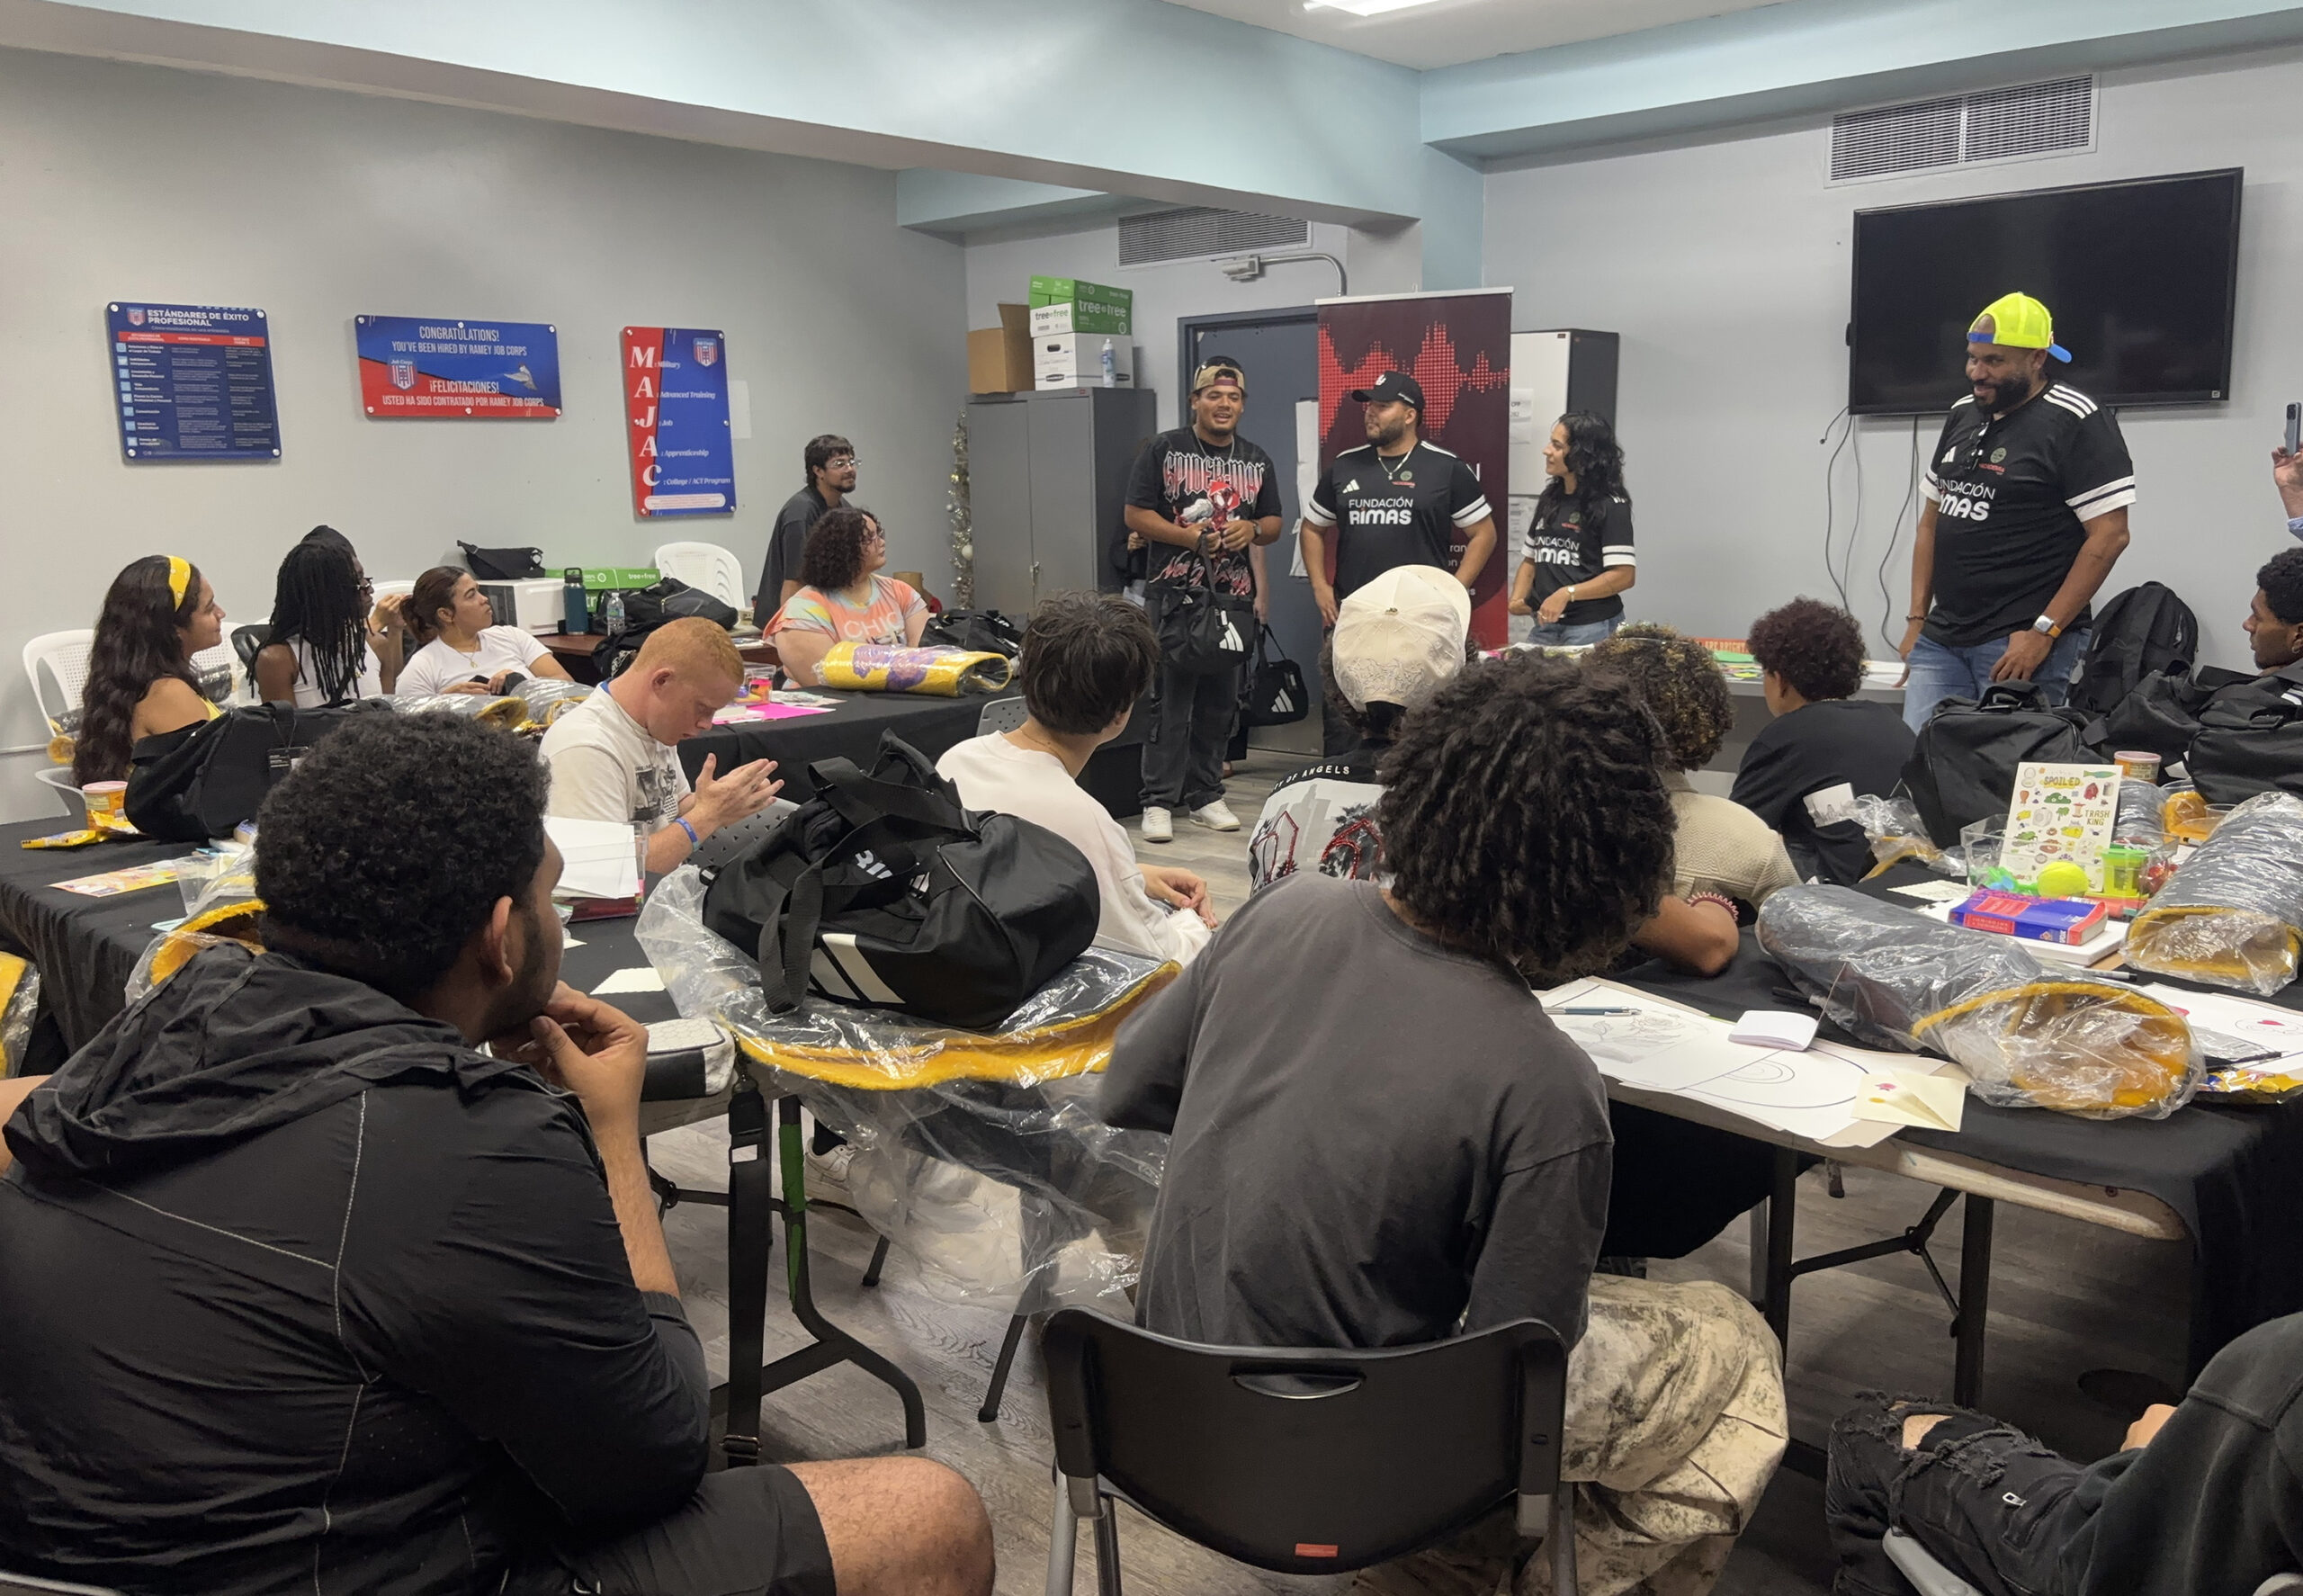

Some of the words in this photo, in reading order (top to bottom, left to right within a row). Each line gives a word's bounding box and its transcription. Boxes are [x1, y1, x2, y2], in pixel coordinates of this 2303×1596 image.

[147, 308, 207, 319] ESTÁNDARES
[209, 312, 221, 320] DE
[222, 312, 249, 321] ÉXITO
[148, 317, 212, 327] PROFESIONAL
[419, 326, 500, 342] CONGRATULATIONS!
[391, 340, 418, 352] YOU'VE
[418, 342, 436, 353] BEEN
[437, 343, 458, 354] HIRED
[459, 344, 468, 354] BY
[469, 345, 494, 354] RAMEY
[494, 345, 506, 355] JOB
[506, 345, 527, 356] CORPS
[690, 390, 716, 400] Training
[382, 395, 405, 406] USTED
[405, 396, 416, 406] HA
[417, 396, 432, 406] SIDO
[433, 396, 475, 407] CONTRATADO
[475, 397, 489, 407] POR
[489, 397, 511, 407] RAMEY
[512, 397, 524, 407] JOB
[524, 398, 544, 408] CORPS
[664, 449, 709, 458] Apprenticeship
[666, 478, 688, 486] College
[703, 477, 731, 486] Program
[1349, 496, 1413, 508] FUNDACIÓN
[1938, 490, 1990, 521] IMAS
[1534, 546, 1580, 566] IMAS
[1286, 773, 1298, 785] OF
[1302, 765, 1350, 778] ANGELS
[2043, 776, 2081, 786] SPOILED
[2084, 810, 2110, 818] TRASH
[2086, 818, 2105, 826] KING
